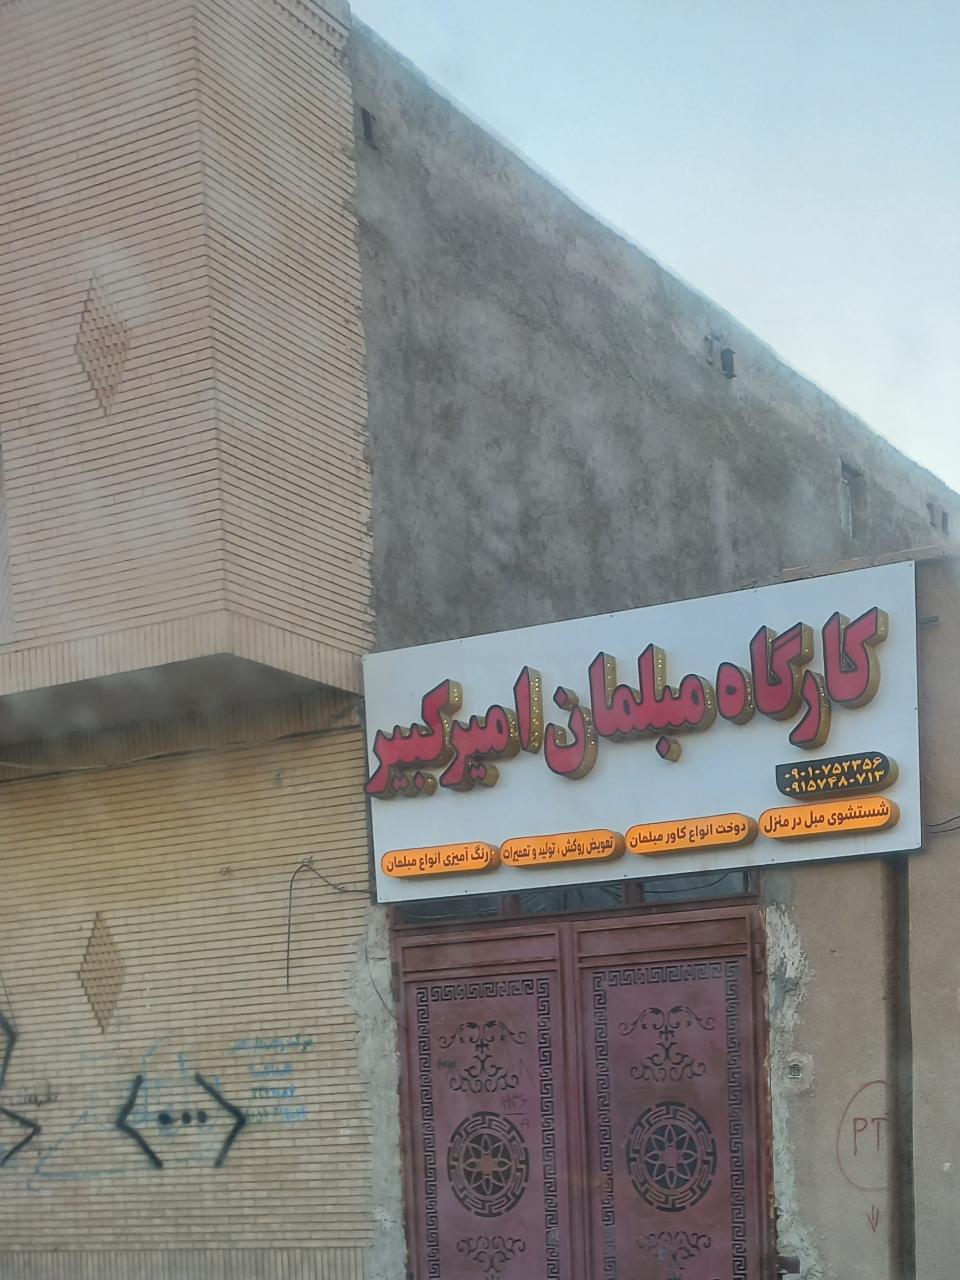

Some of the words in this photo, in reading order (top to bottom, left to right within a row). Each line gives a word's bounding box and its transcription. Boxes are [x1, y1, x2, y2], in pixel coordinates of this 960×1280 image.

[717, 606, 889, 750] کارگاه
[544, 643, 717, 780] مبلمان
[804, 810, 825, 829] مبل
[827, 801, 889, 827] شستشوی
[715, 822, 746, 836] دوخت
[764, 815, 789, 834] منزل
[791, 816, 802, 831] در
[629, 831, 664, 849] مبلمان
[665, 826, 687, 844] کاور
[688, 824, 713, 842] انواع
[470, 845, 489, 863] رنگ
[502, 845, 530, 862] تعمیرات
[532, 849, 537, 860] و
[538, 842, 556, 859] تولید
[586, 836, 614, 855] تعویض
[386, 856, 417, 873] مبلمان
[419, 852, 441, 871] انواع
